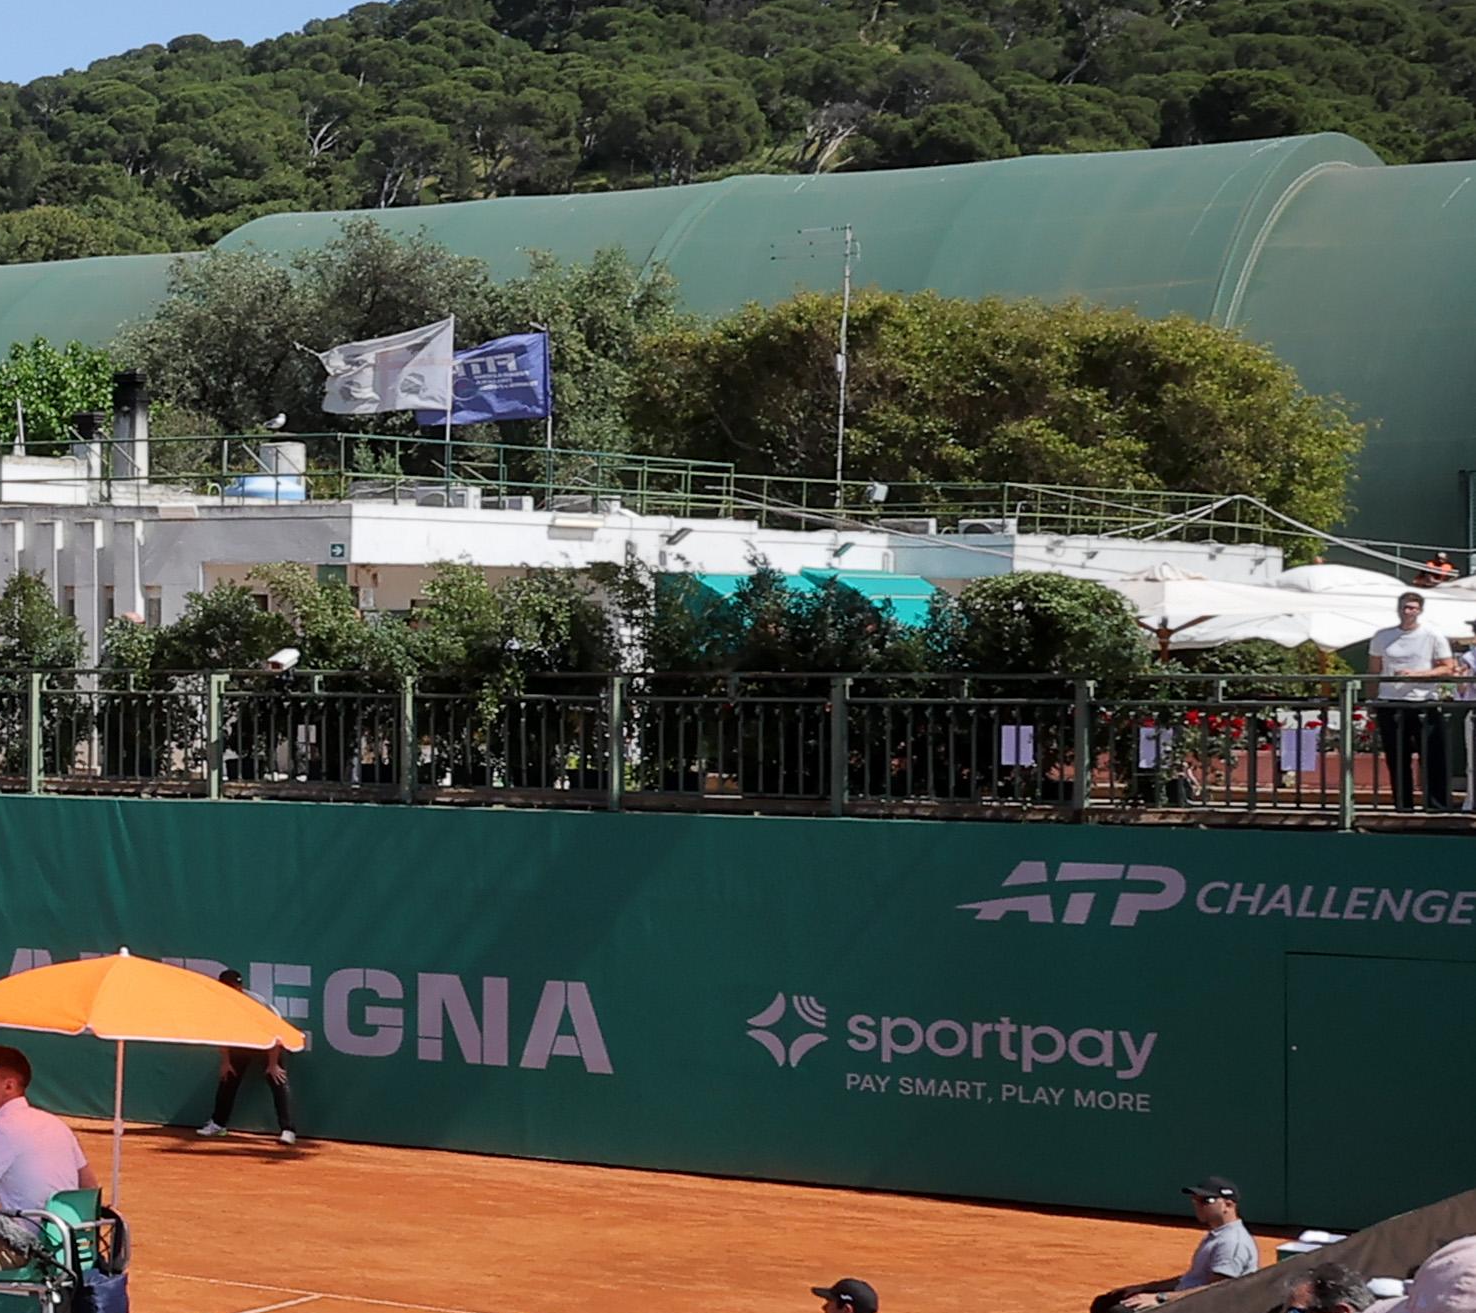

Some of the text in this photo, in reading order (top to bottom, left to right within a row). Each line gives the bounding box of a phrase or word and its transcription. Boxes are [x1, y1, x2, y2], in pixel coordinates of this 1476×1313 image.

[955, 860, 1187, 927] ATP
[846, 1013, 1159, 1080] sportpay
[845, 1073, 1152, 1113] PAY SMART, PLAY MORE
